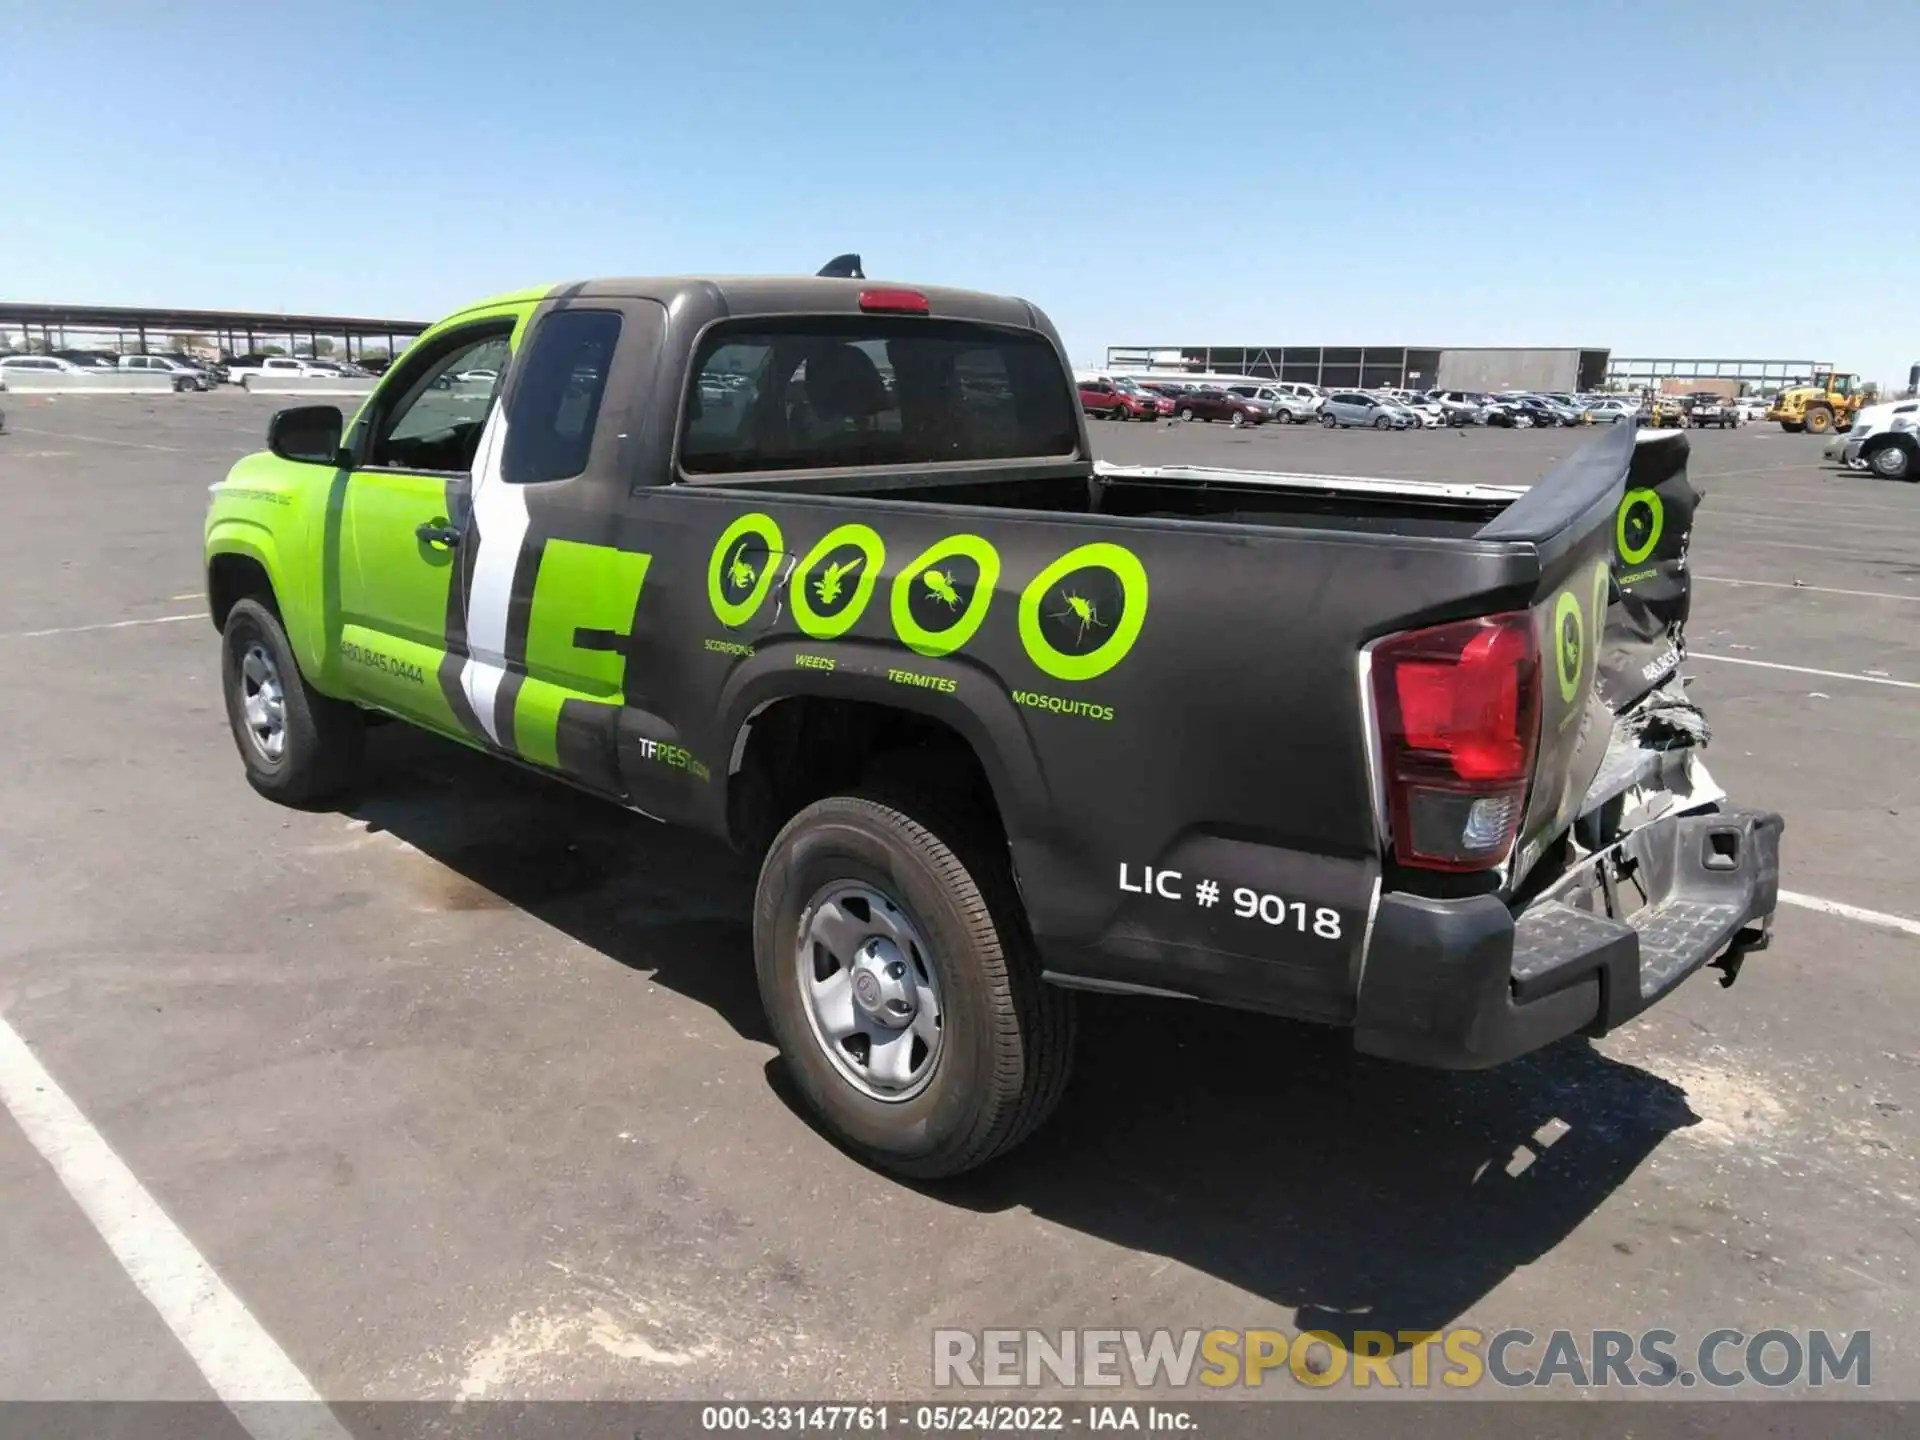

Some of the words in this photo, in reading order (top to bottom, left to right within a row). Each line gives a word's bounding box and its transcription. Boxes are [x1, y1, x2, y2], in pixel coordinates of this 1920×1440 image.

[704, 639, 756, 657] SCORPIONS
[795, 654, 836, 671] WEEDS
[888, 668, 958, 693] TERMITES
[1012, 690, 1114, 721] MOSQUITOS
[1119, 862, 1182, 900] LIC
[1196, 879, 1220, 908] #
[1233, 887, 1342, 940] 9018
